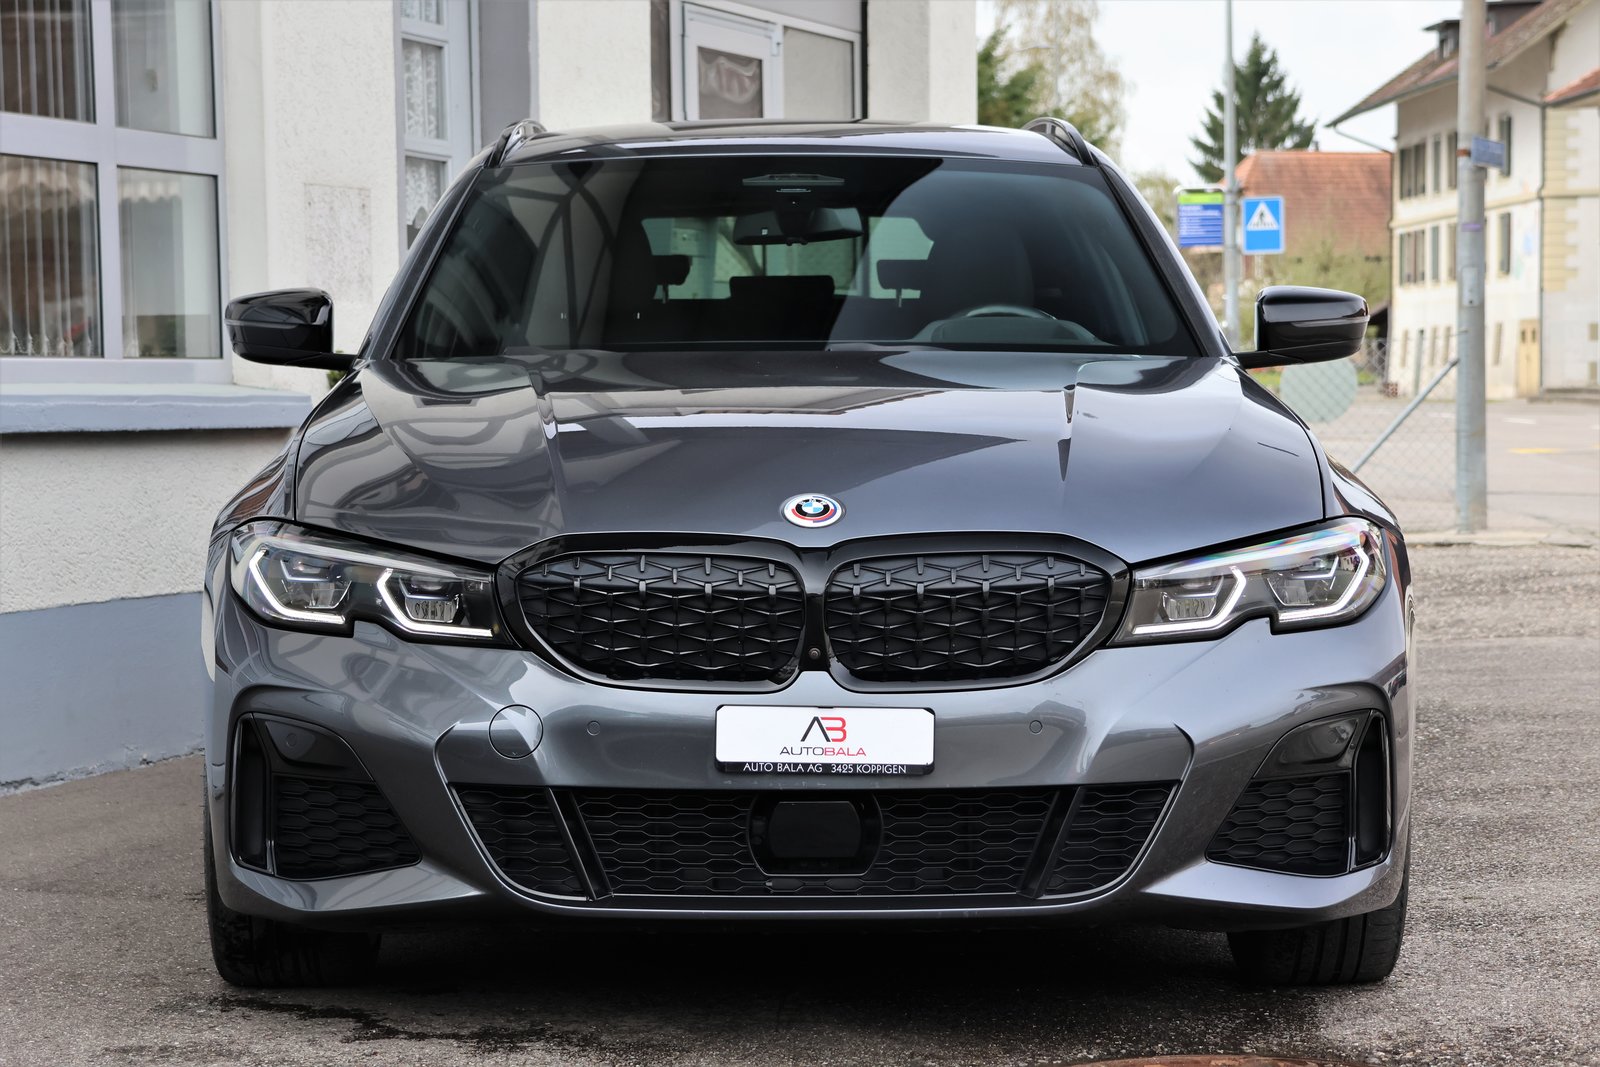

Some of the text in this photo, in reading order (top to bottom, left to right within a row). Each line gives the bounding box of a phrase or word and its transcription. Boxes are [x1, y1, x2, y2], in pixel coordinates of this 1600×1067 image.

[779, 746, 866, 757] AUTOBALA
[743, 762, 907, 775] AUTO BALA AG 3425 KOPPIGEN
